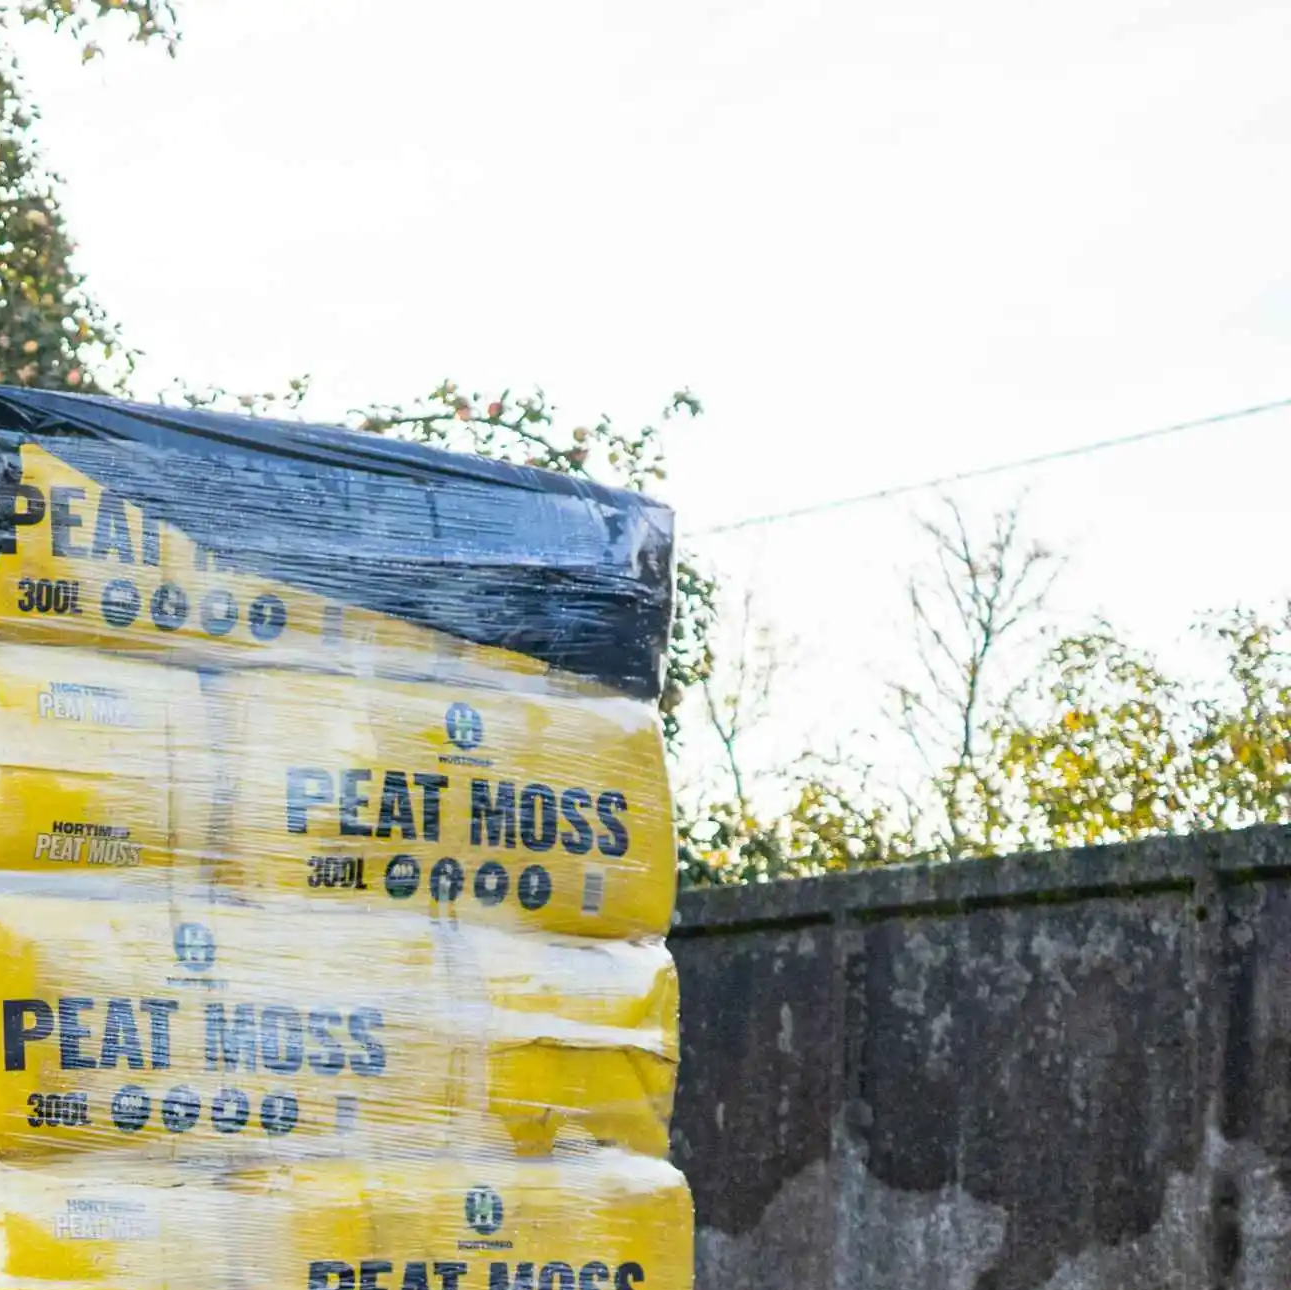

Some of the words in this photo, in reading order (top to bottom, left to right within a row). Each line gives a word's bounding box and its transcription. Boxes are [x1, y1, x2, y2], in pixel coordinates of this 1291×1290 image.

[18, 578, 84, 615] 300L
[286, 767, 448, 842] PEAT
[470, 778, 629, 857] MOSS
[35, 834, 84, 864] PEAT
[307, 855, 368, 890] 300L
[3, 997, 179, 1072] PEAT
[205, 1002, 387, 1077] MOSS
